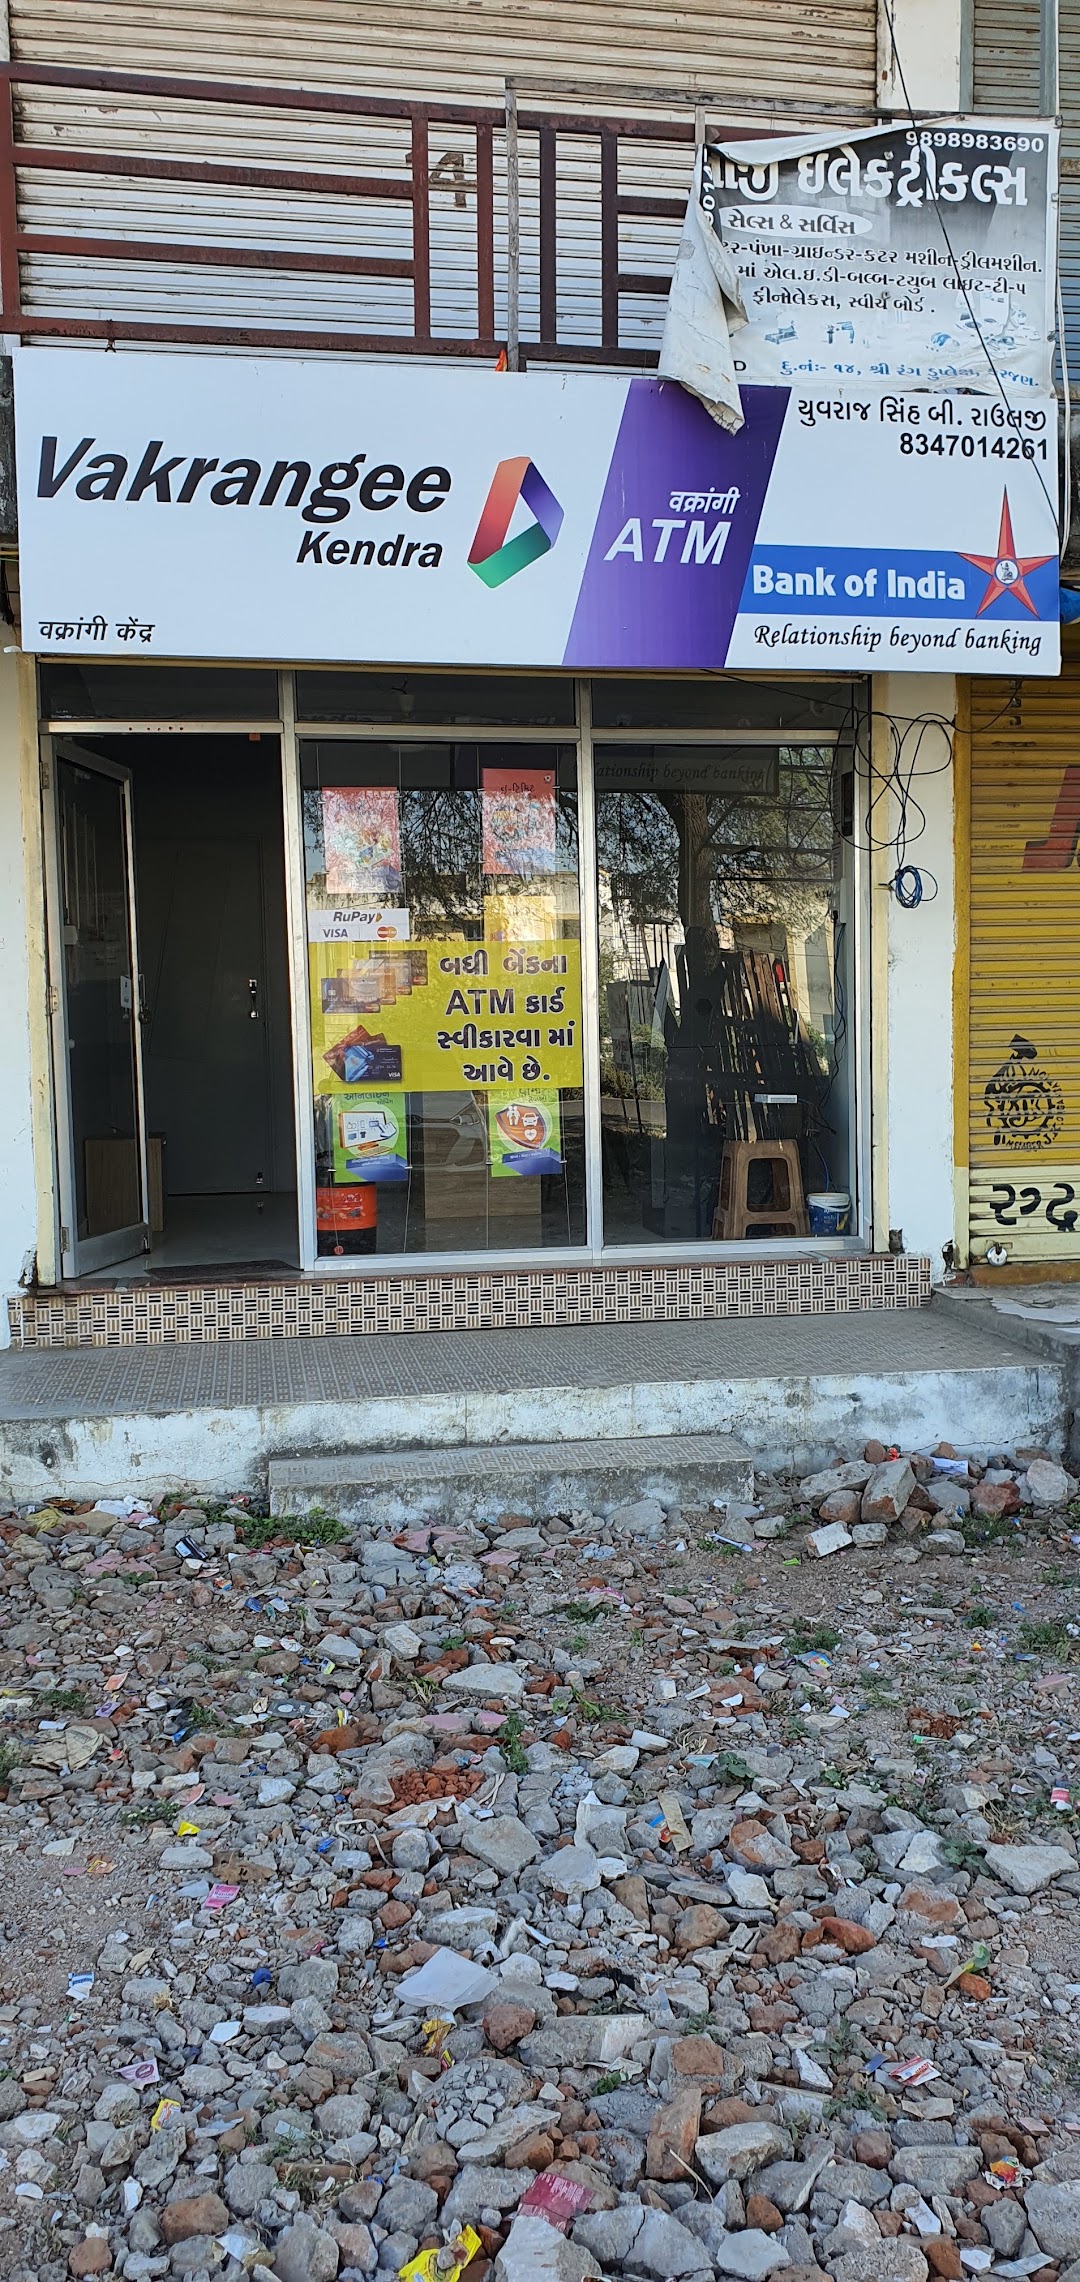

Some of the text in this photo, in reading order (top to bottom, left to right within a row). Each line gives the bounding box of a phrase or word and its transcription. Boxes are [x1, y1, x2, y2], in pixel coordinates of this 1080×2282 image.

[906, 131, 1044, 152] 9898983690
[728, 209, 855, 234] સેલ્સ & સર્વિસ
[738, 262, 756, 277] માં
[869, 363, 890, 376] શ્રી
[798, 396, 1046, 431] યુવરાજ સિંહ બી. રાઉલજી
[900, 432, 1047, 460] 8347014261
[36, 435, 452, 523] Vakrangee
[668, 487, 740, 515] वक्रांगी
[297, 530, 443, 568] Kendra
[603, 517, 732, 565] ATM
[753, 564, 966, 601] Bank of India
[39, 615, 155, 644] वक्रांगी केंद्र
[754, 624, 1042, 656] Relationship beyond banking
[333, 912, 376, 924] RuPay
[323, 928, 348, 938] VISA
[502, 947, 567, 975] બેંકના
[445, 986, 565, 1015] ATM કાર્ડ
[437, 1020, 576, 1049] સ્વીકારવા માં
[463, 1055, 513, 1082] આવે
